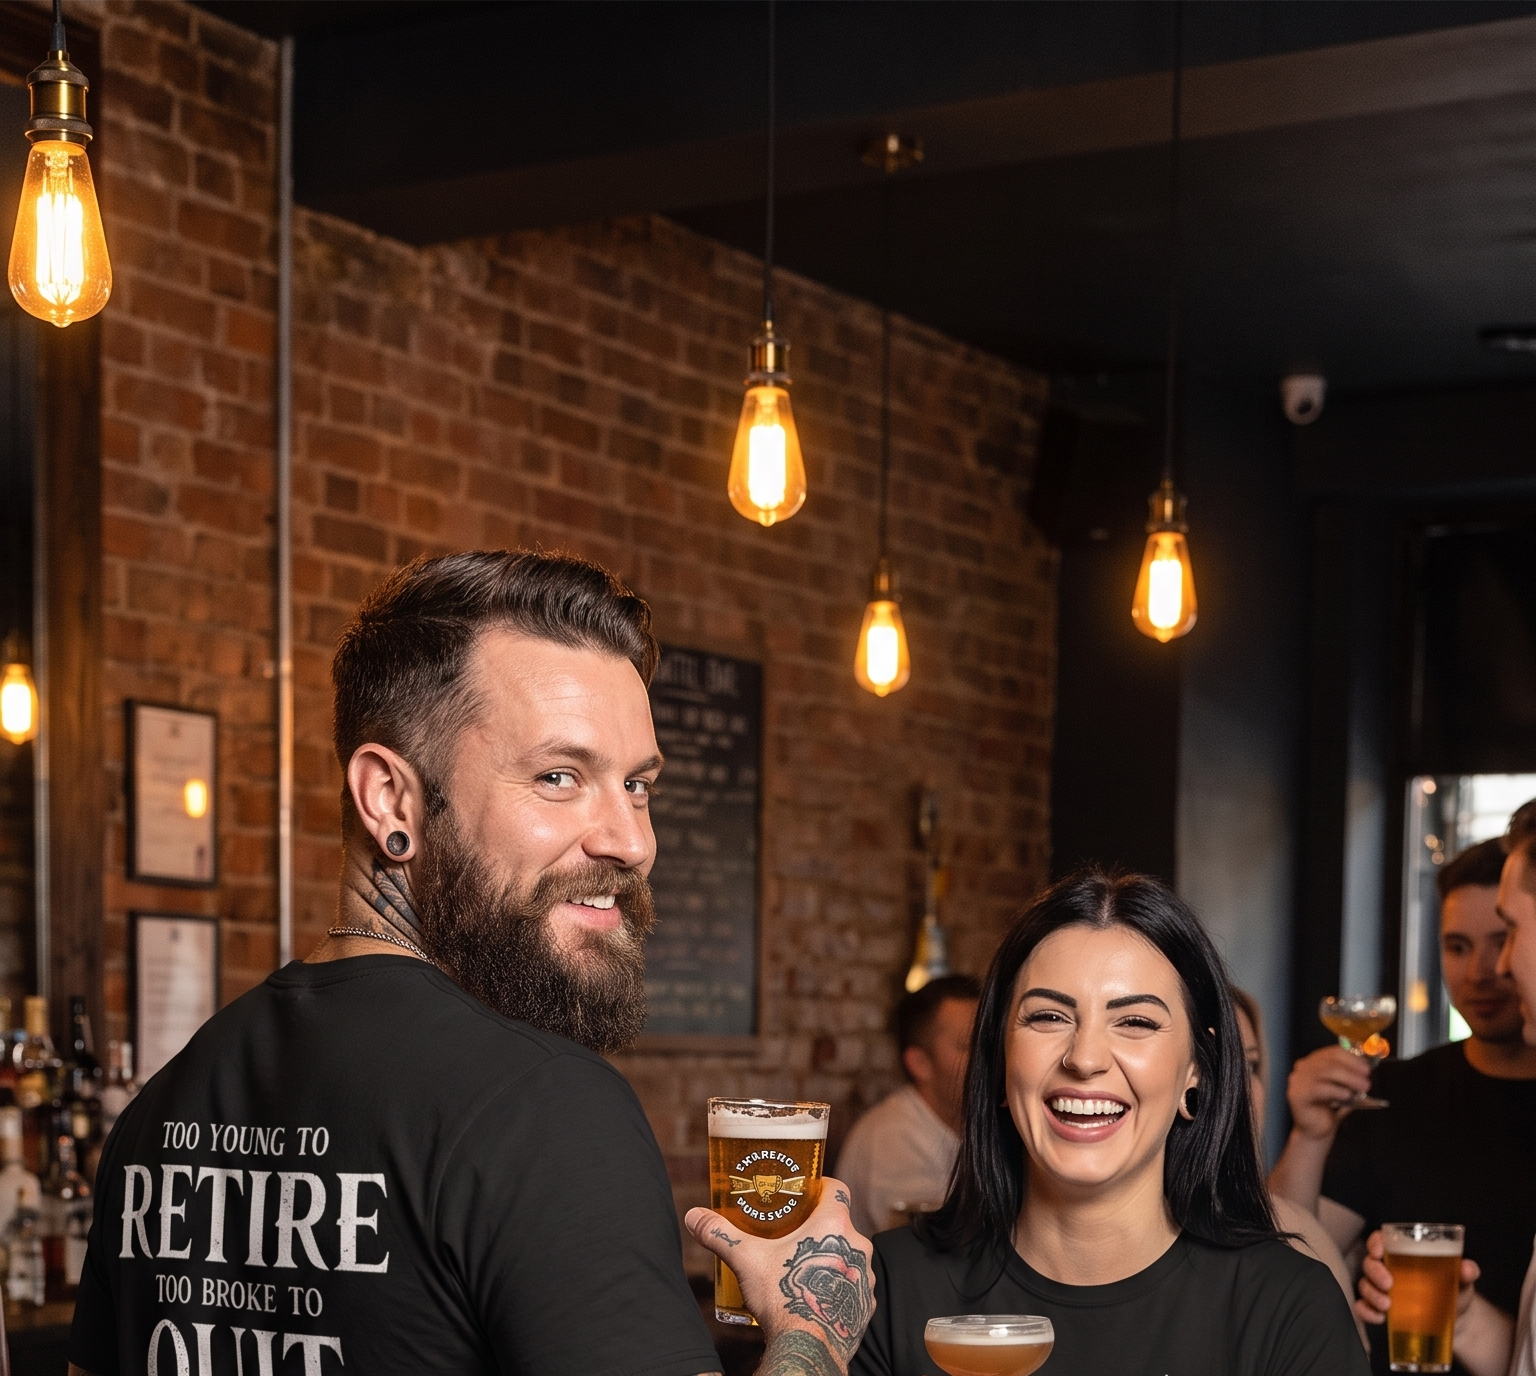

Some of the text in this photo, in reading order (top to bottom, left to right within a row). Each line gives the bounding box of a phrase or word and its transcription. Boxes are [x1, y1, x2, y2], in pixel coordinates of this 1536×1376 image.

[162, 1121, 330, 1157] TOO YOUNG TO
[118, 1163, 390, 1274] RETIRE
[155, 1274, 323, 1317] TOO BROKE TO
